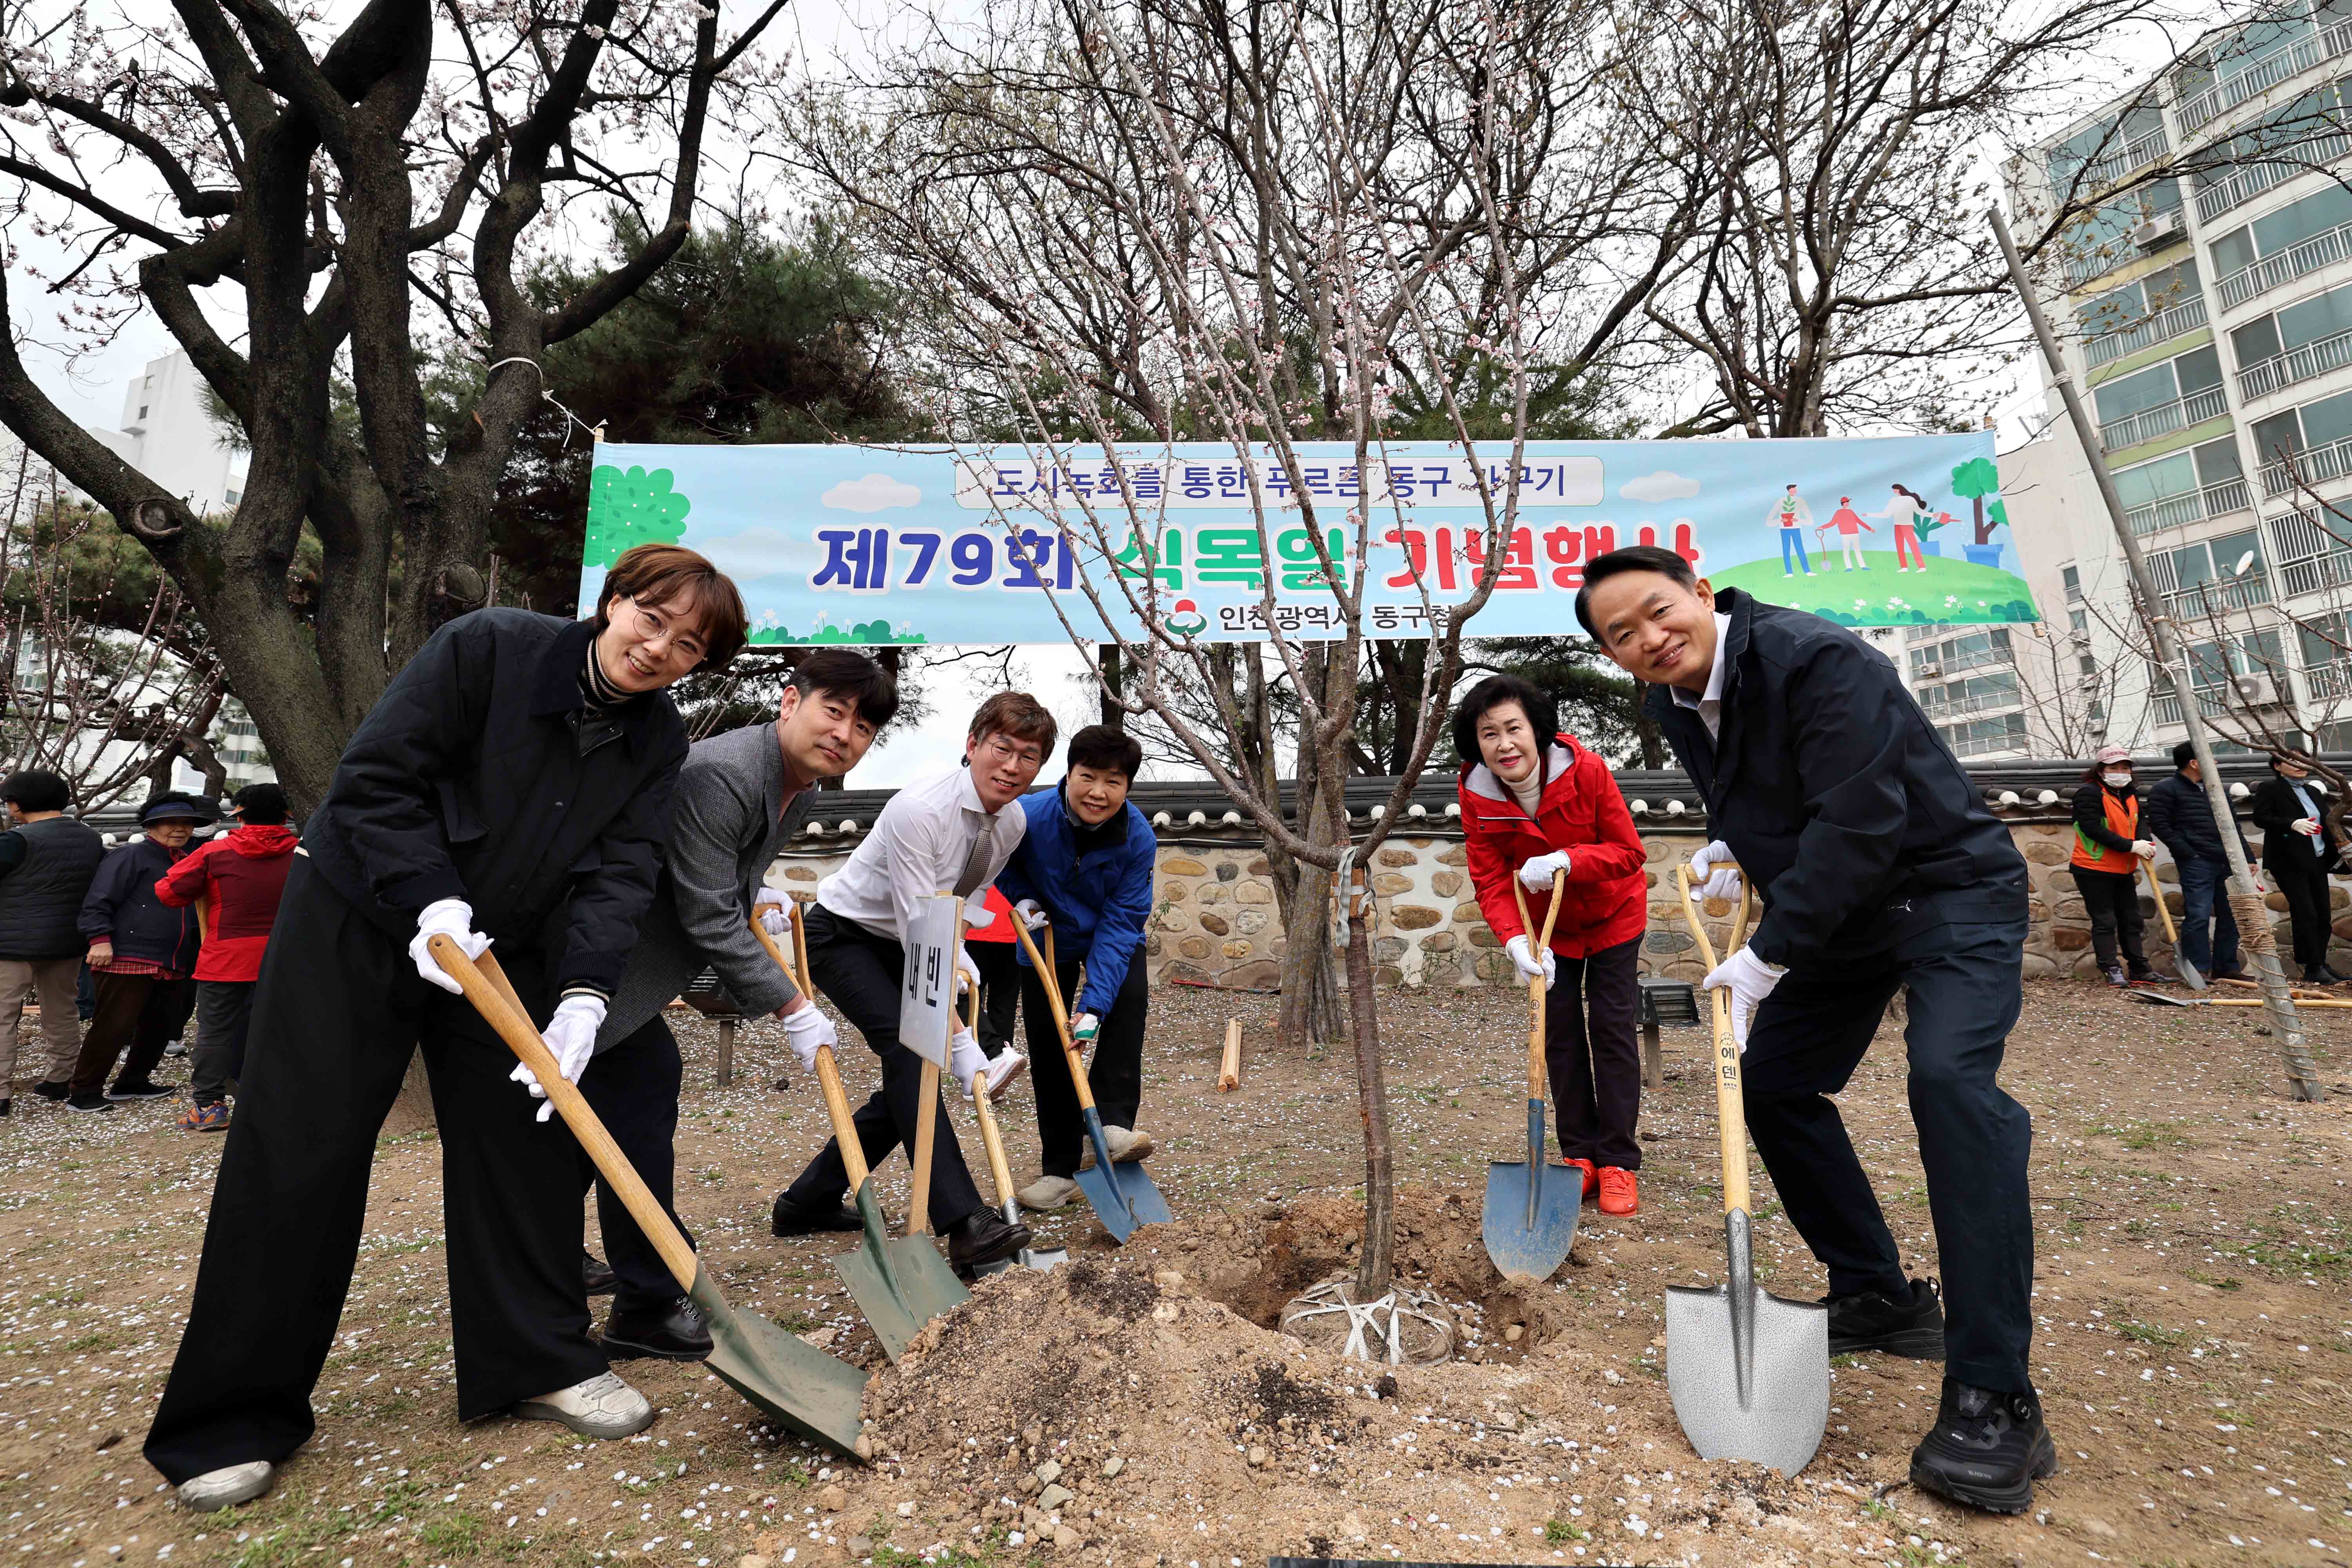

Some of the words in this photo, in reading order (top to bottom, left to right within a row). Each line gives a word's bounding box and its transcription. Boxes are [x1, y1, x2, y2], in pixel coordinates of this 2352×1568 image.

[994, 467, 1161, 499] 도시녹화를
[1181, 466, 1249, 498] 통한
[1265, 466, 1359, 498] 푸르른
[1385, 466, 1452, 497] 동구
[813, 528, 1073, 589] 제79회
[1113, 528, 1349, 590] 식목일
[1372, 605, 1453, 629] 동구청
[909, 942, 941, 1008] 내빈
[1722, 1047, 1736, 1080] 에덴
